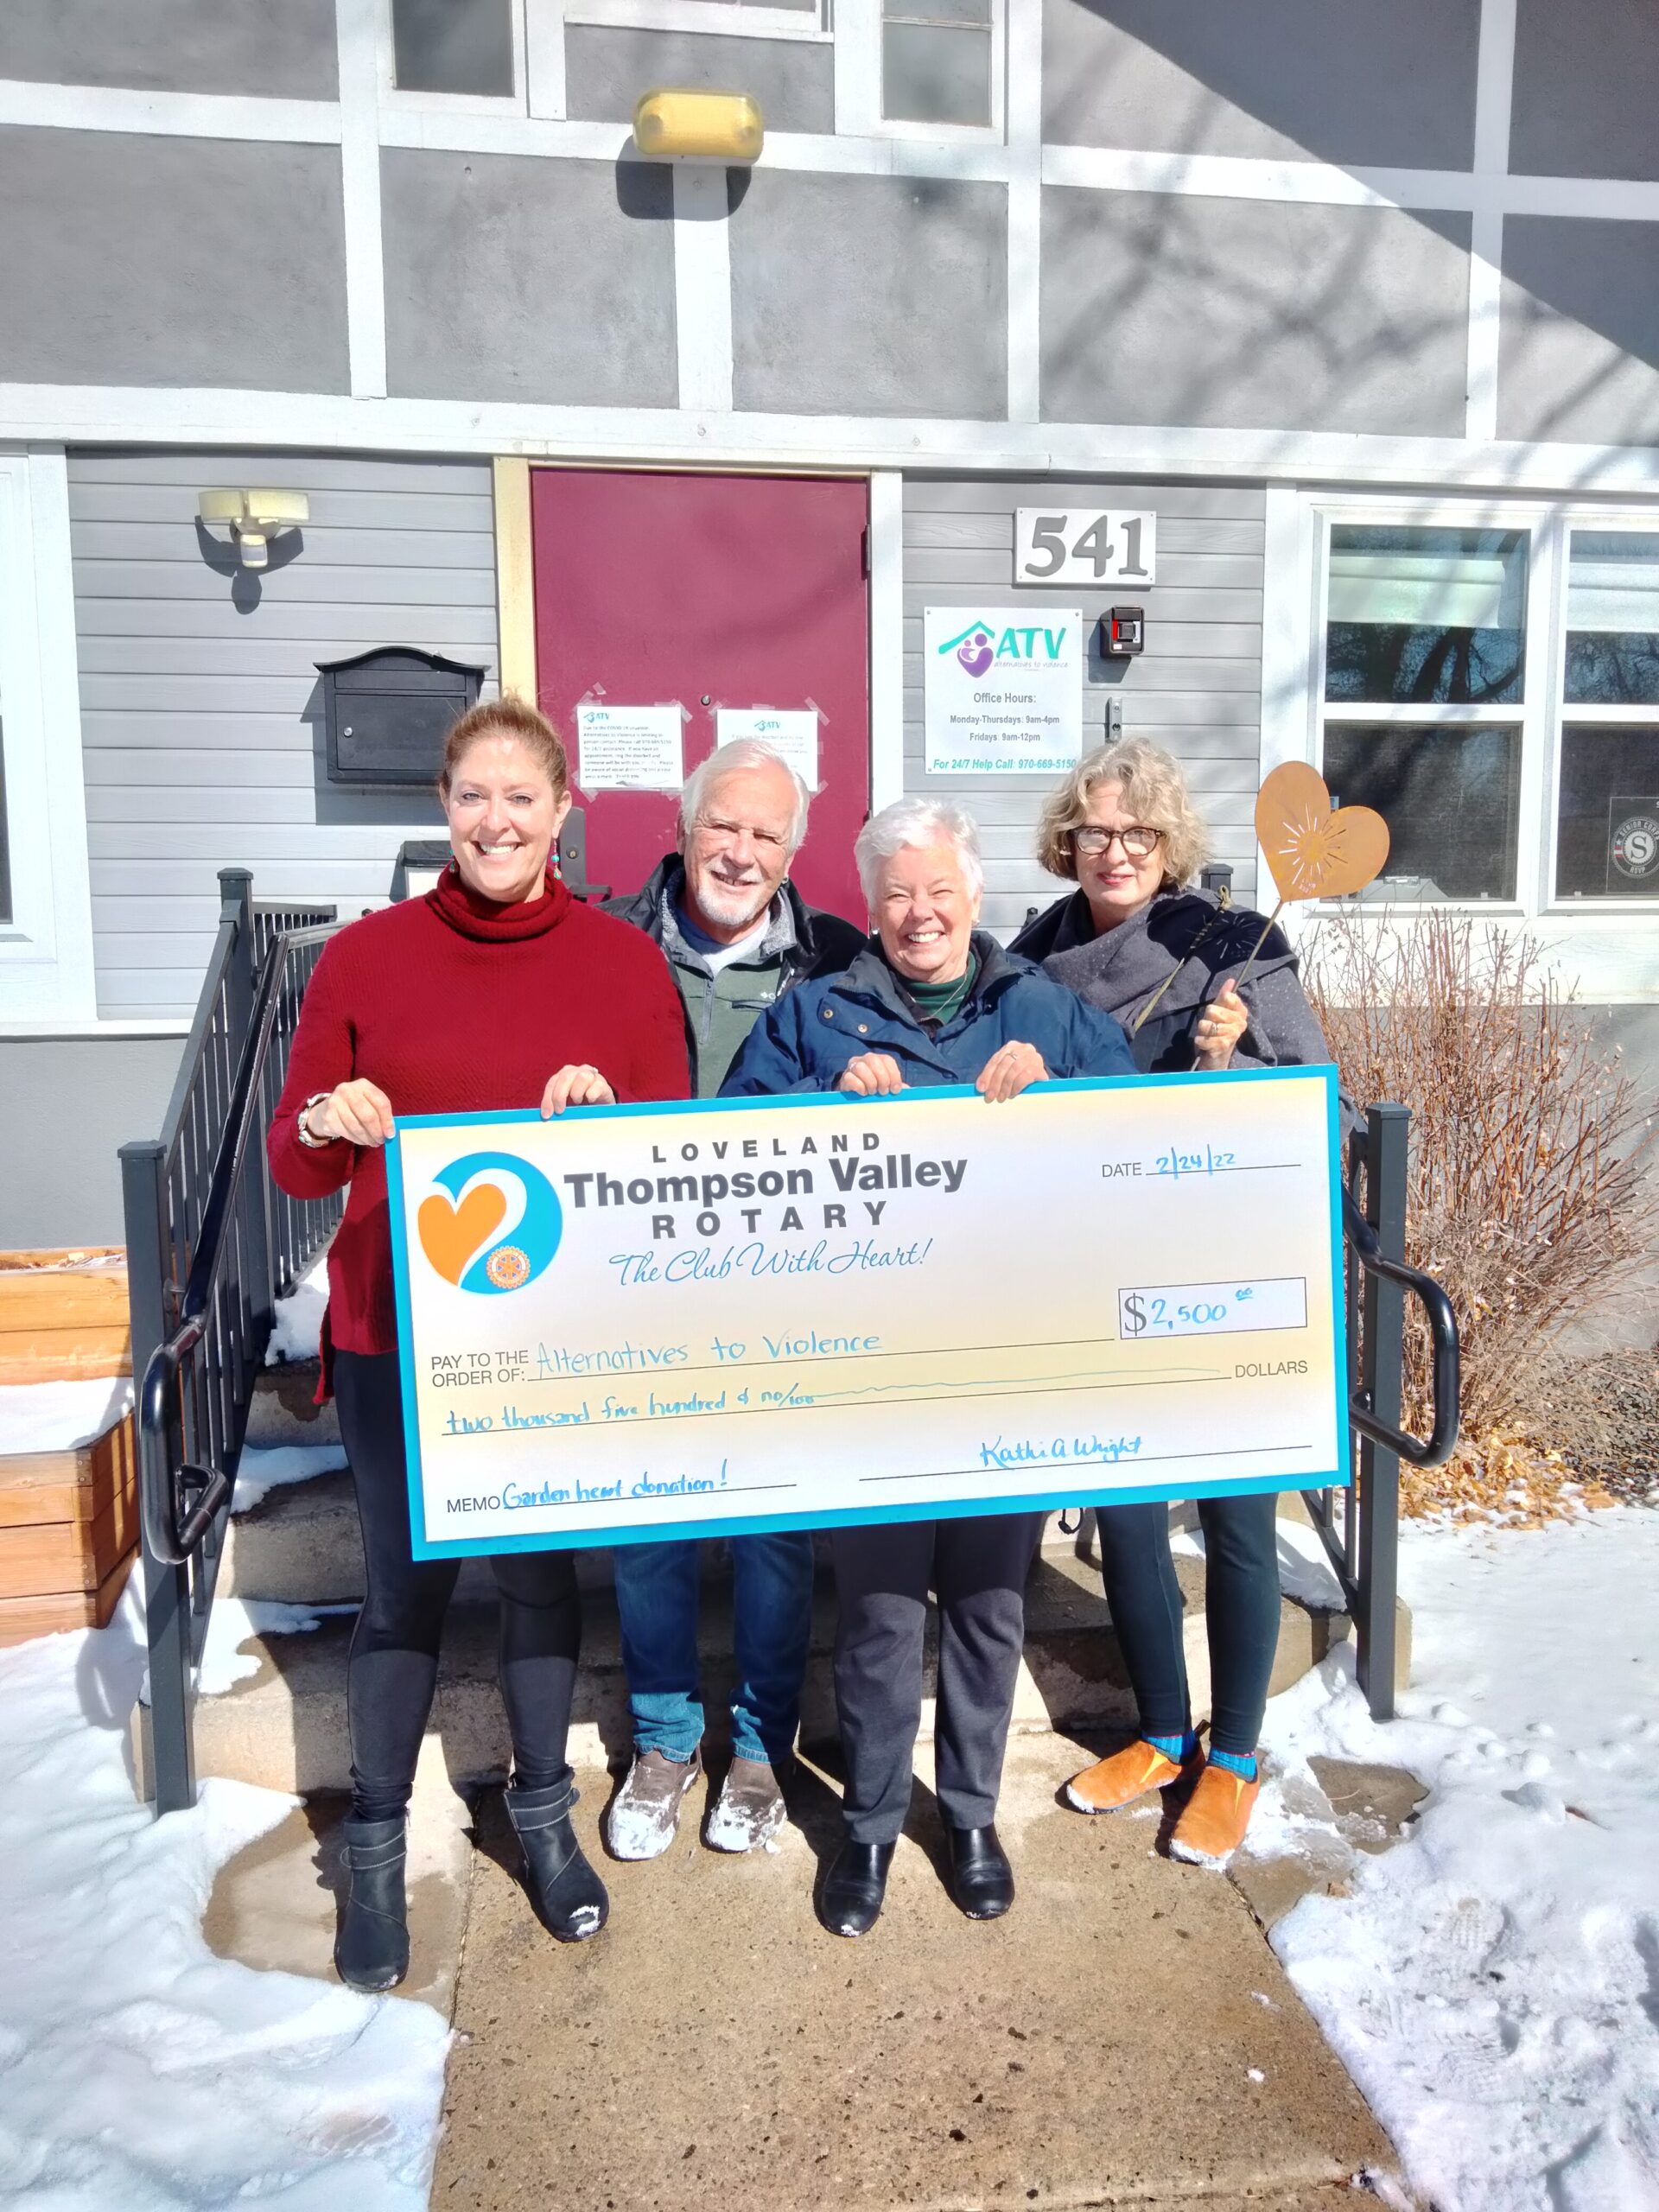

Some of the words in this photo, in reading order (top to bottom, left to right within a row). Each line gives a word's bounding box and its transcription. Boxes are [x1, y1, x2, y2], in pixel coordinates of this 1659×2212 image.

[1025, 515, 1148, 577] 541
[996, 627, 1066, 659] ATV
[974, 693, 1001, 703] Office
[1004, 693, 1037, 703] Hours:
[950, 715, 1024, 725] Monday-Thursdays:
[1026, 715, 1059, 725] 9am-4pm
[1001, 733, 1040, 742] 9am-12pm
[933, 760, 949, 768] For
[951, 760, 969, 768] 24/7
[972, 760, 993, 771] Help
[995, 760, 1016, 768] Call:
[1018, 760, 1077, 769] 970-669-5150
[1619, 820, 1642, 836] SENIOR
[1631, 836, 1647, 859] S
[1630, 866, 1646, 874] RSVP
[652, 1132, 880, 1163] LOVELAND
[1101, 1162, 1142, 1178] DATE
[1155, 1143, 1236, 1179] 2/24/22
[563, 1166, 814, 1208] Thompson
[828, 1154, 968, 1193] Valley
[652, 1200, 887, 1239] ROTARY
[609, 1250, 661, 1285] The
[664, 1246, 734, 1282] Club
[735, 1239, 827, 1276] With
[827, 1238, 933, 1274] Heart!
[431, 1355, 462, 1370] PAY
[467, 1353, 491, 1367] TO
[495, 1350, 529, 1365] THE
[537, 1340, 689, 1380] Alternatives
[710, 1337, 746, 1361] to
[762, 1329, 882, 1359] Violence
[432, 1370, 493, 1388] ORDER
[497, 1369, 525, 1382] OF:
[1235, 1360, 1308, 1378] DOLLARS
[447, 1410, 493, 1434] two
[501, 1402, 590, 1428] thousand
[601, 1395, 638, 1419] five
[650, 1390, 726, 1415] hundred
[980, 1435, 1046, 1470] Kathi
[446, 1497, 501, 1513] MEMO
[502, 1481, 570, 1510] Garden
